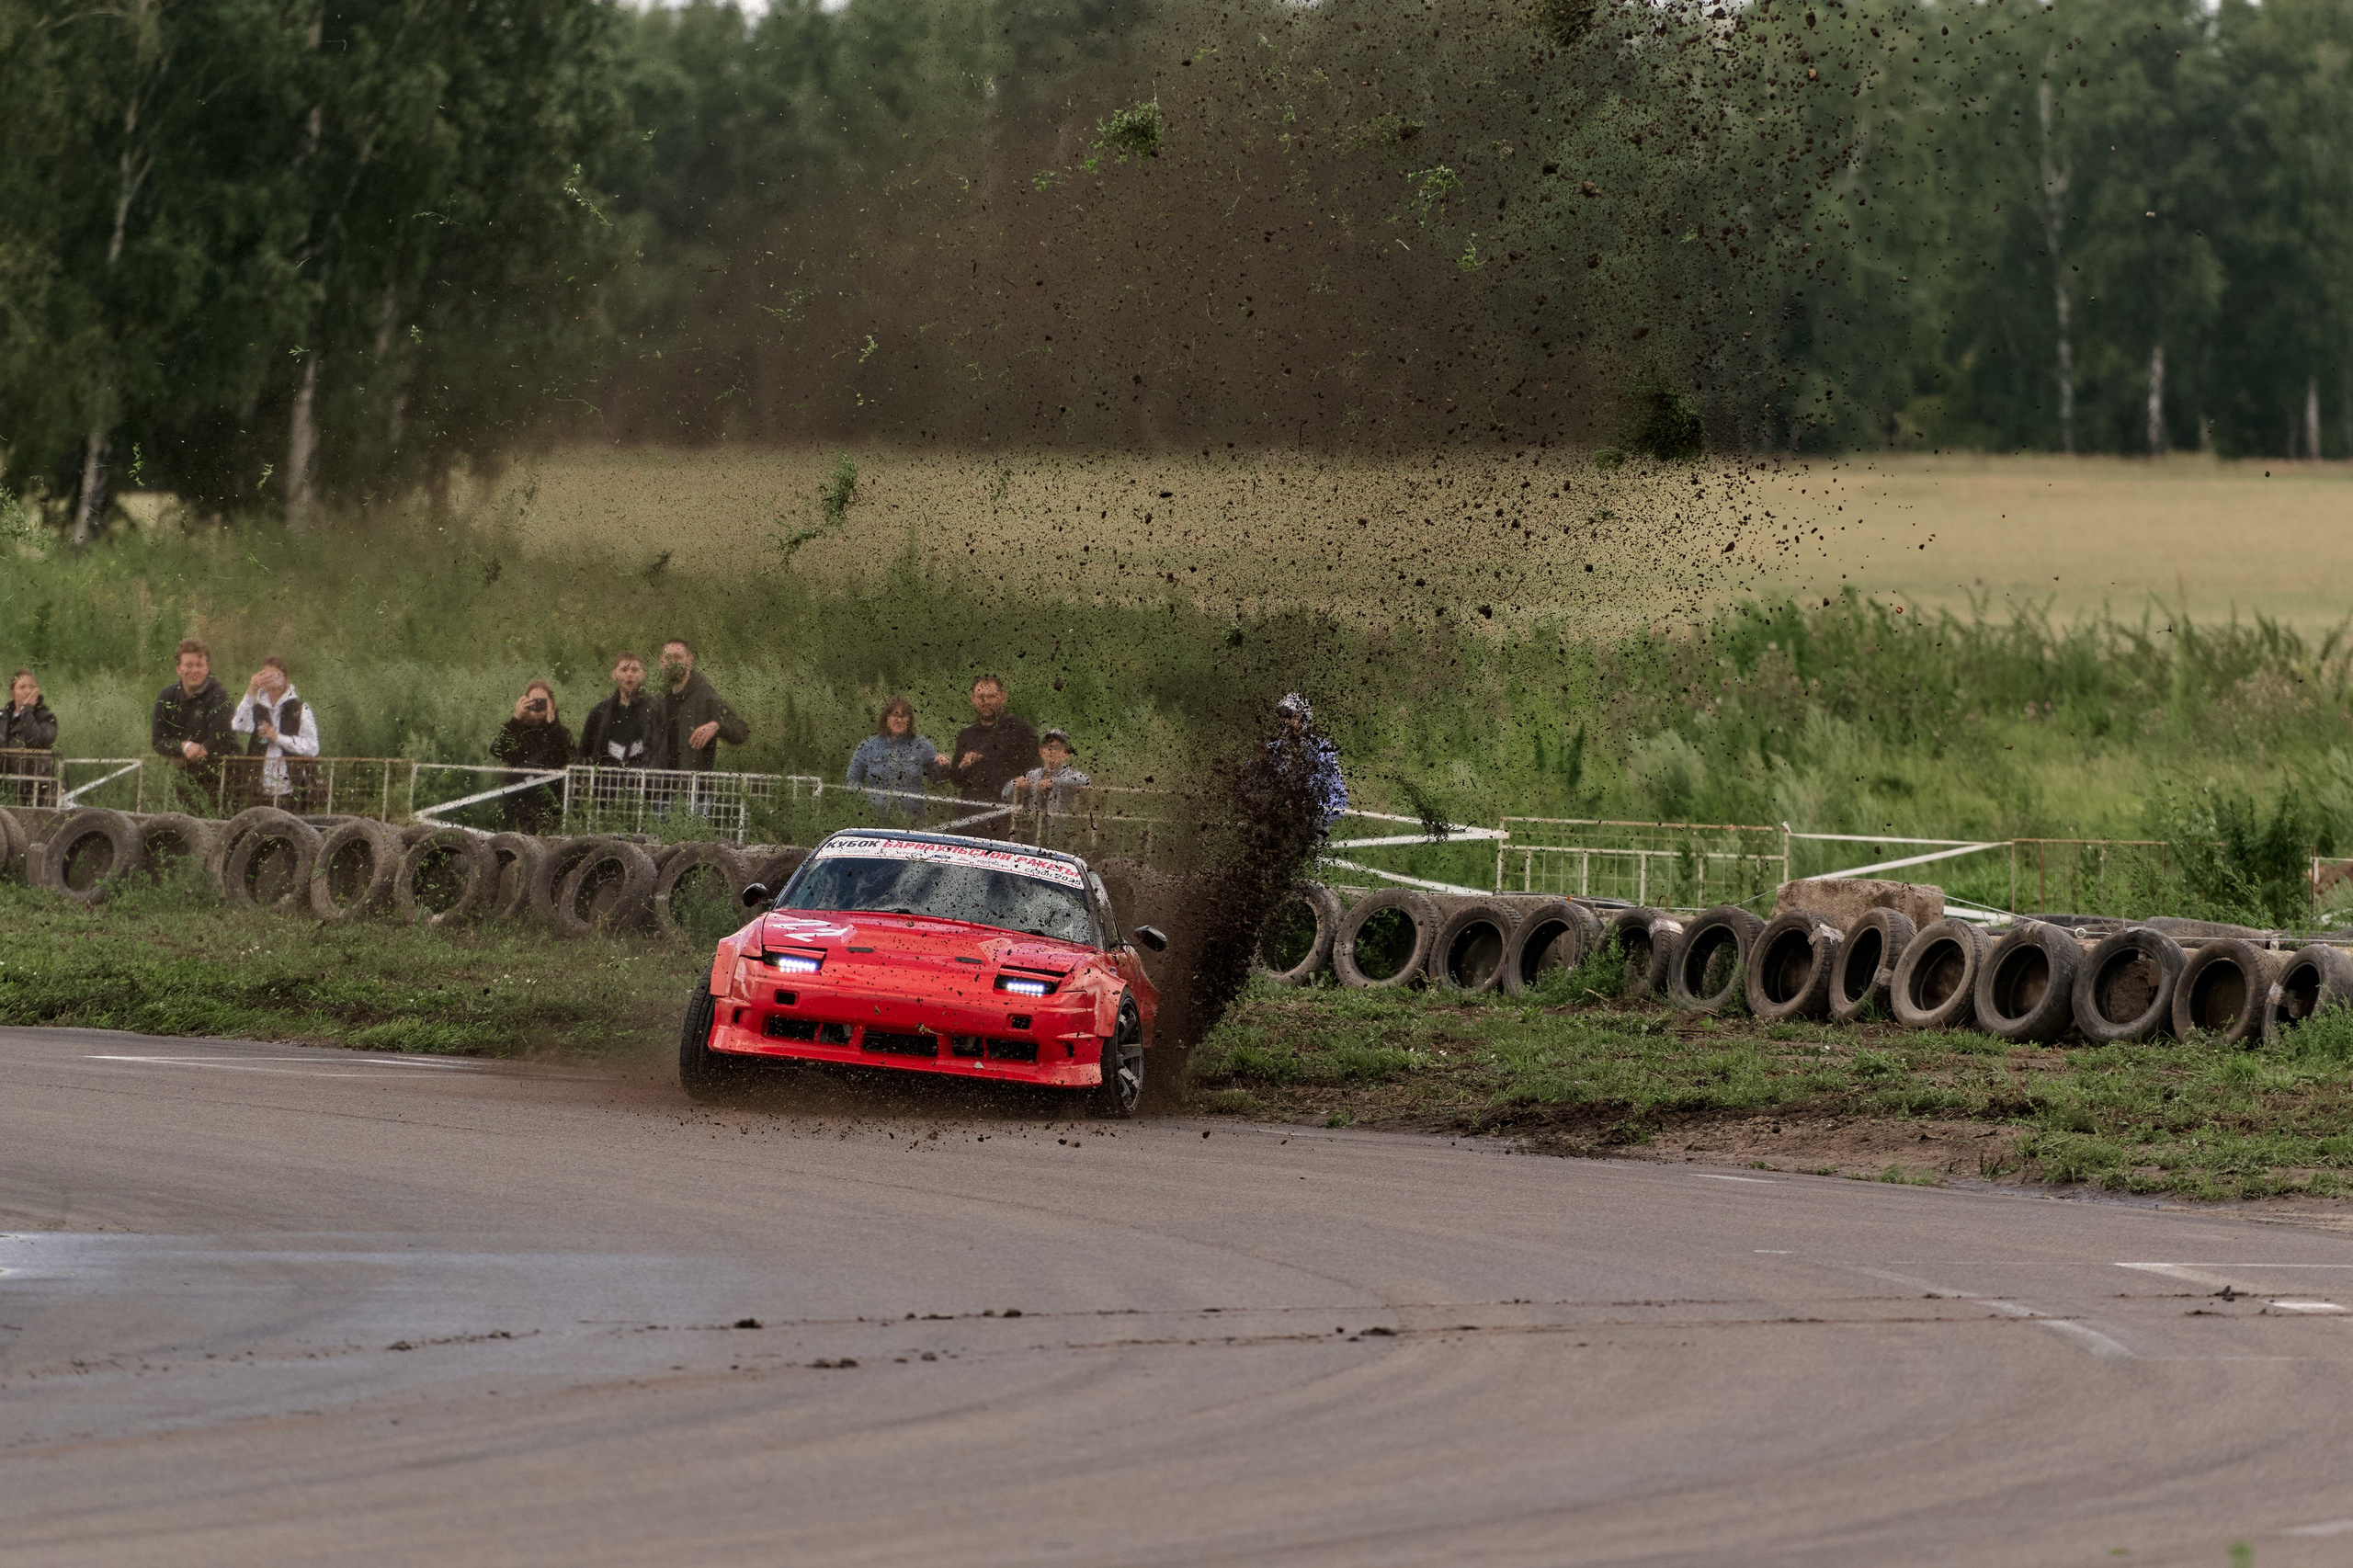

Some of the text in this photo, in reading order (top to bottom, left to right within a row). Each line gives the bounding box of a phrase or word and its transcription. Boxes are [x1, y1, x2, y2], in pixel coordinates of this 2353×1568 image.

[825, 840, 880, 848] КУБОК
[882, 840, 1012, 862] БАРНАУЛЬСКОЙ
[1016, 856, 1081, 878] РАКЕТЫ
